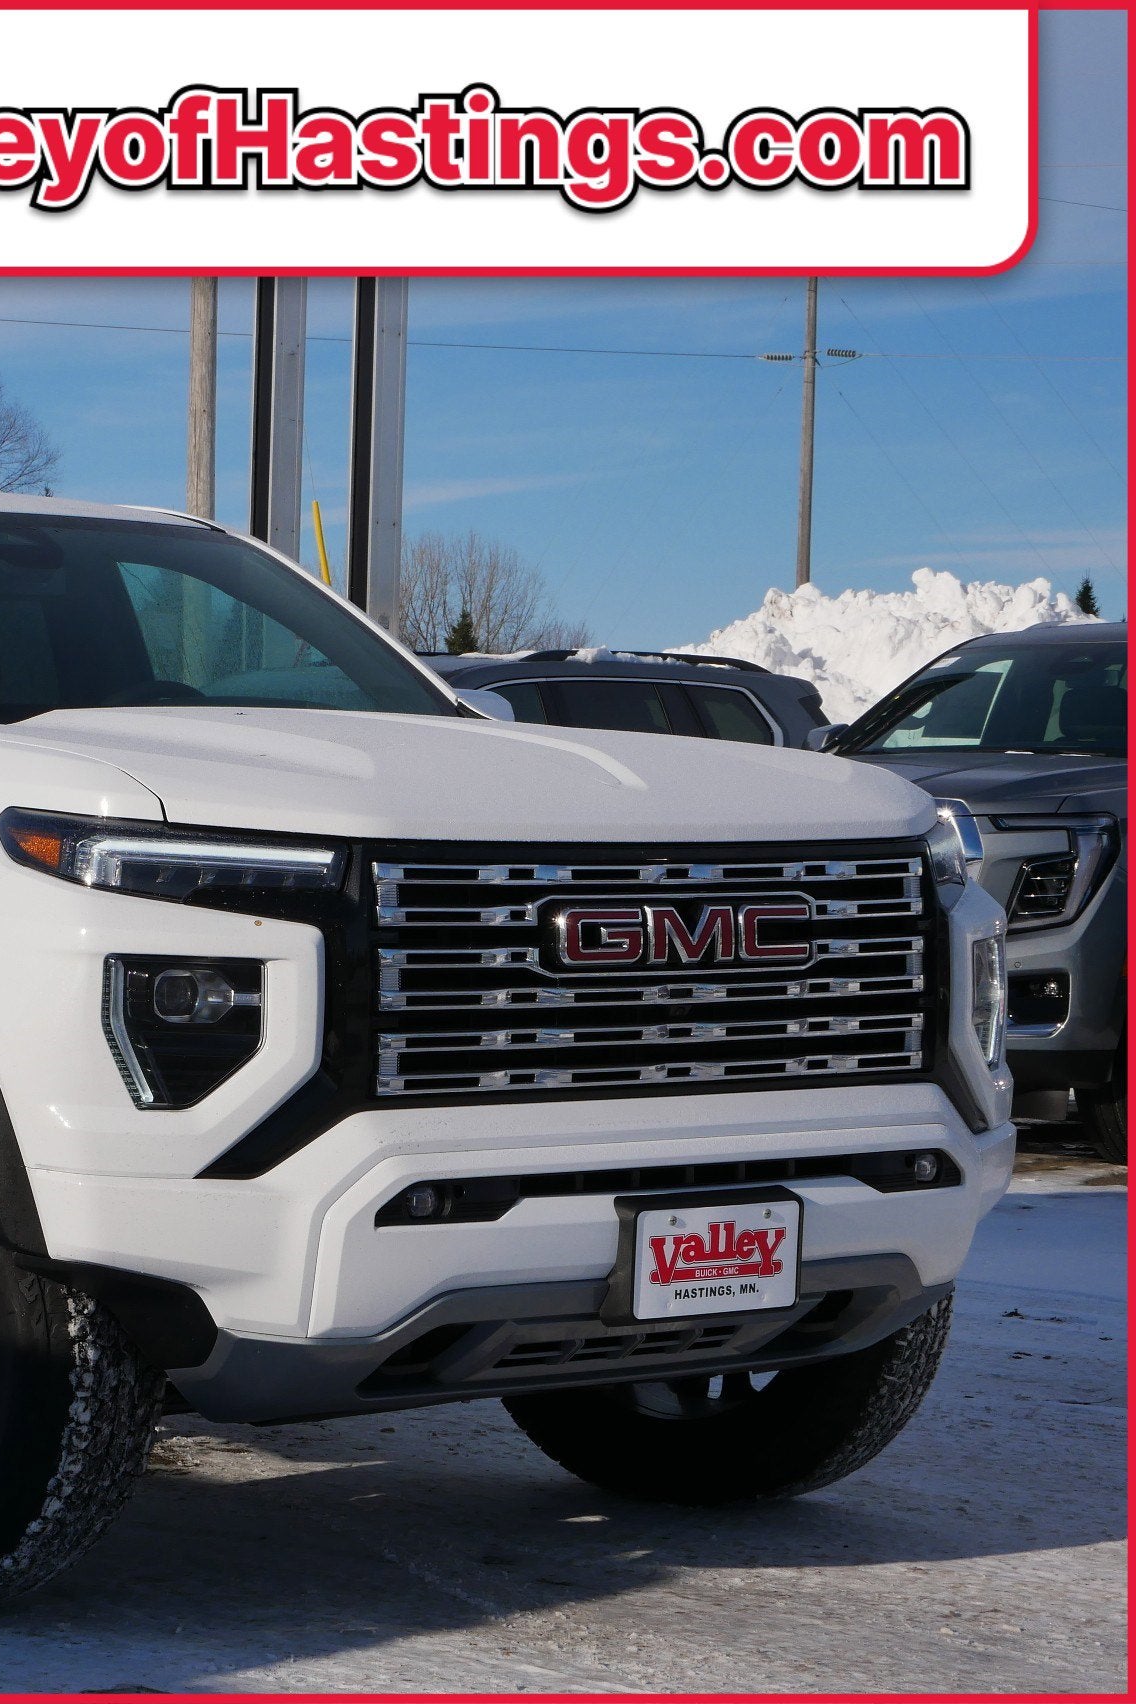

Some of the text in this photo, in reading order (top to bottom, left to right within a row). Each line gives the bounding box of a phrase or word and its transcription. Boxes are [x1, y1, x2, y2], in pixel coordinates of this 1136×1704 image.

[558, 904, 810, 965] GMC
[695, 1266, 740, 1278] BUICK GMC
[674, 1283, 759, 1300] HASTINGS, MN.
